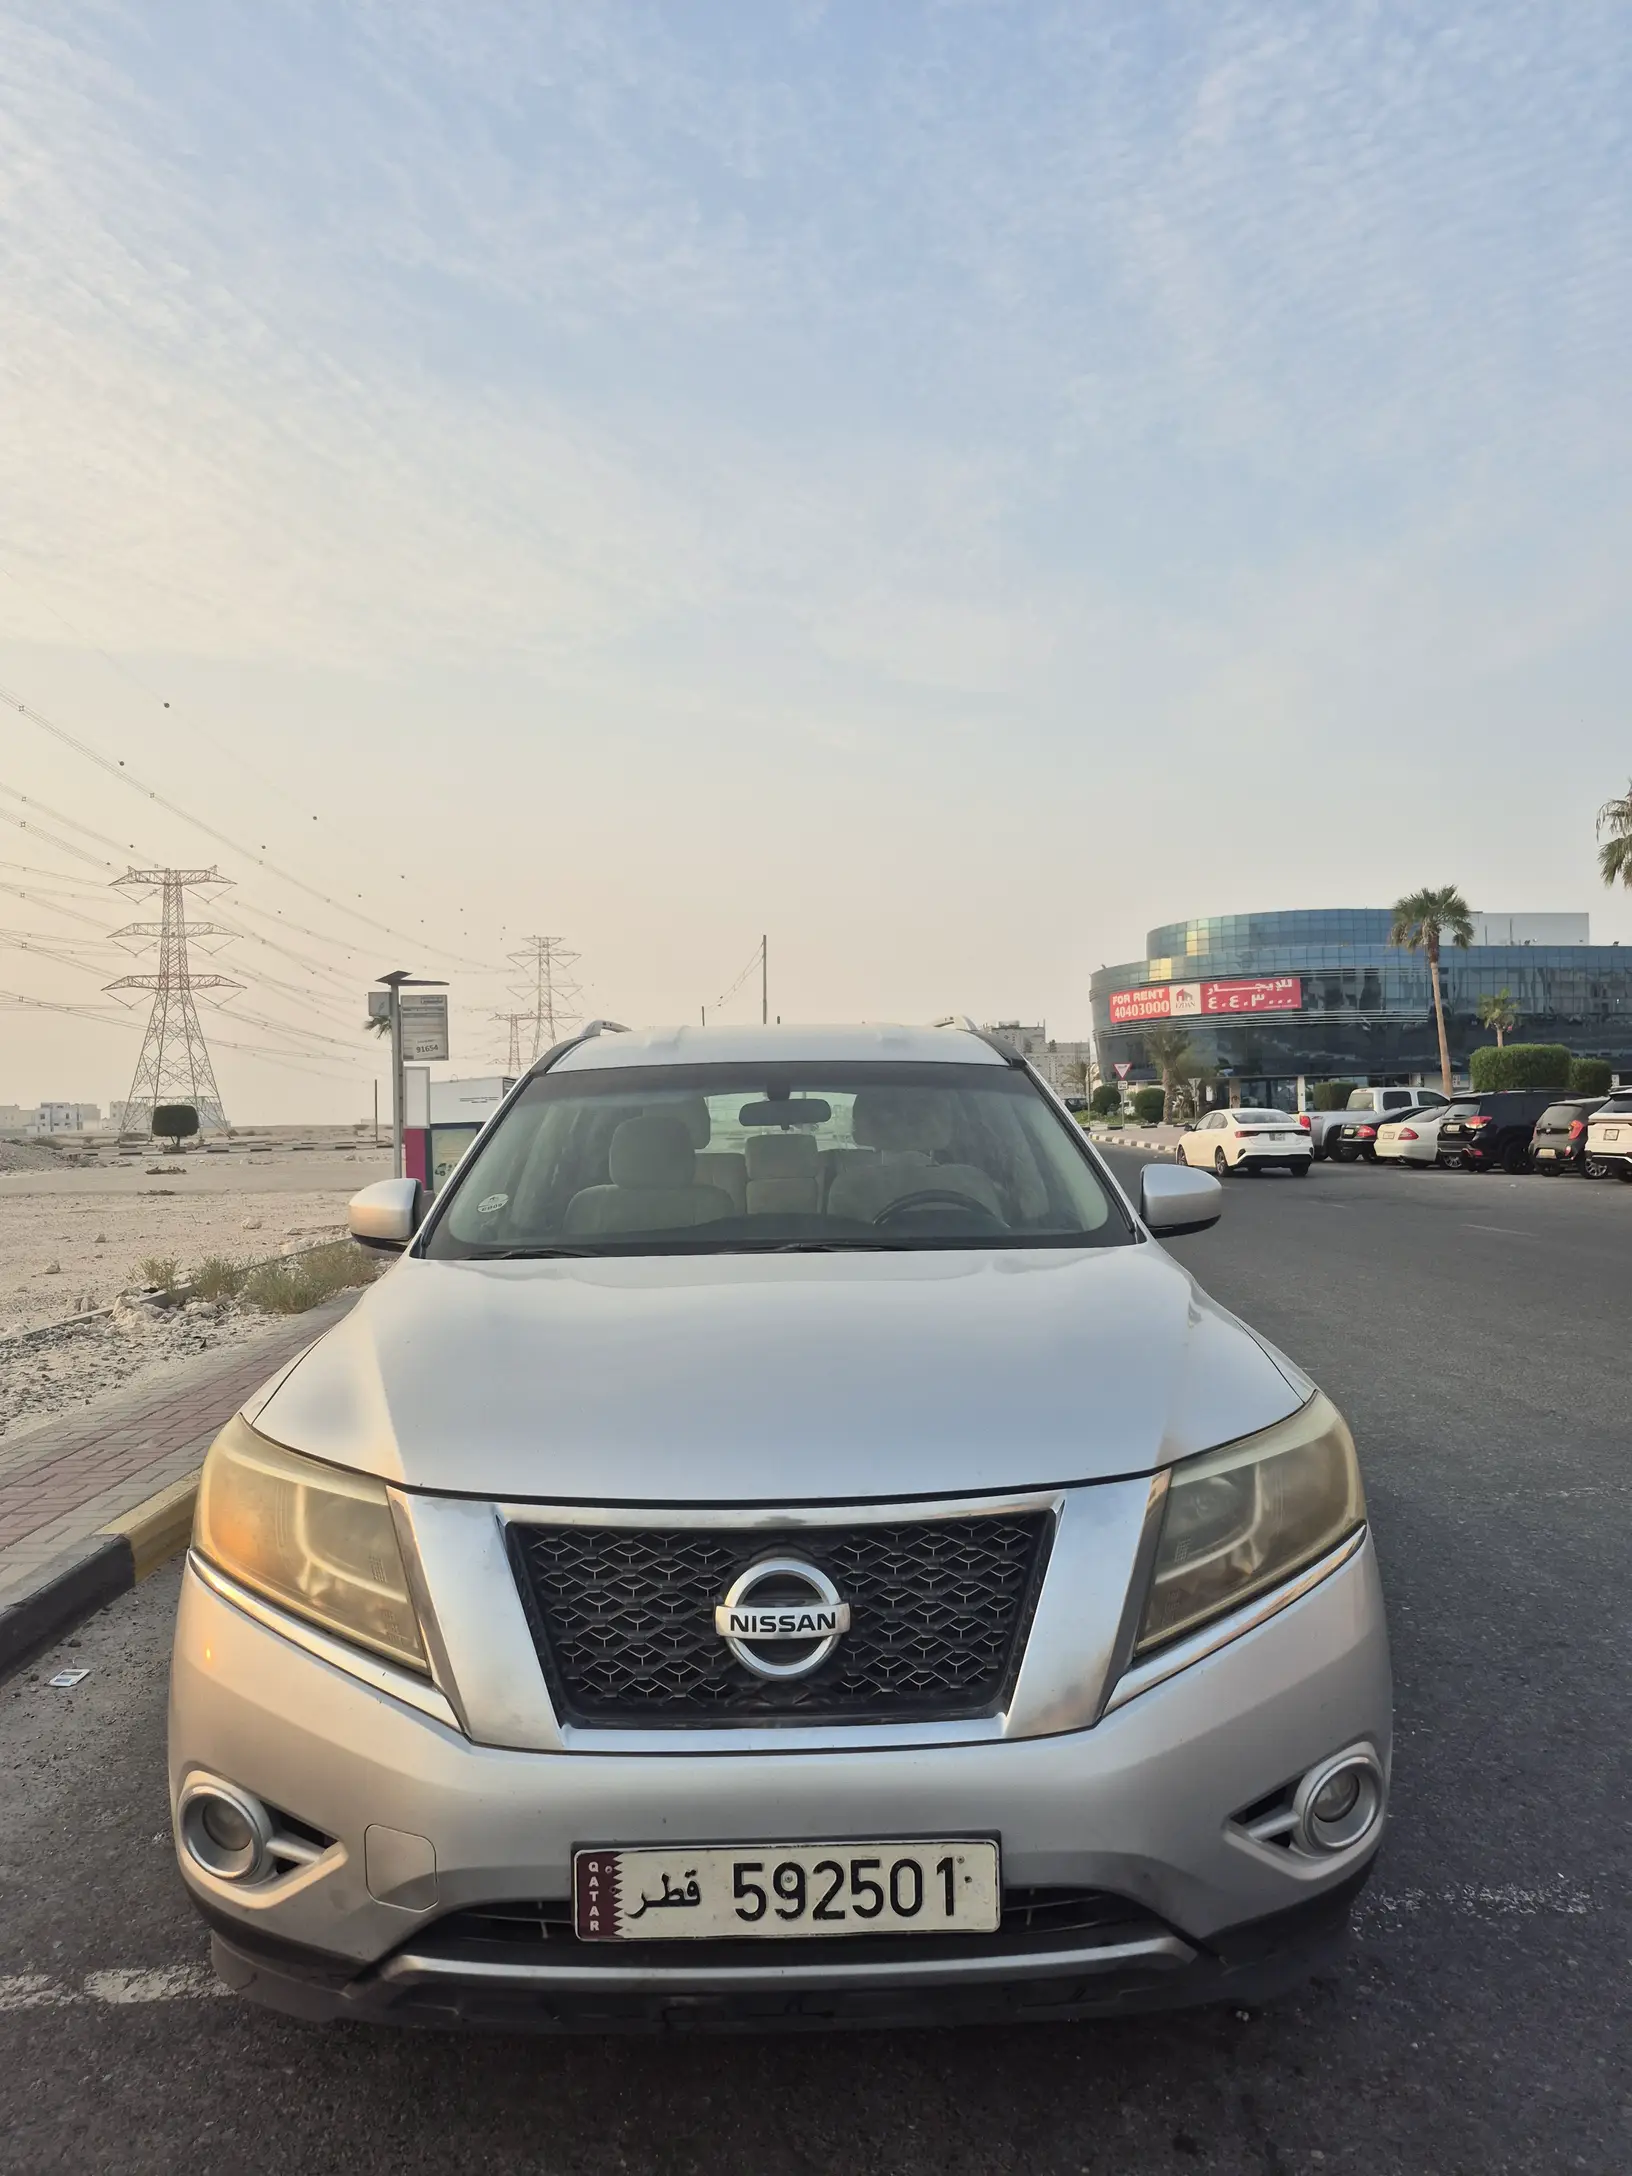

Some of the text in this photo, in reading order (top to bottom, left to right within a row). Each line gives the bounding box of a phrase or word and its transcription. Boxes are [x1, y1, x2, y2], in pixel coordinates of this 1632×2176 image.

[1112, 988, 1166, 1005] FOR RENT
[1115, 1000, 1170, 1019] 40403000
[730, 1612, 836, 1633] NISSAN
[588, 1861, 600, 1932] QATAR
[624, 1869, 701, 1919] قطر
[733, 1857, 955, 1922] 592501
